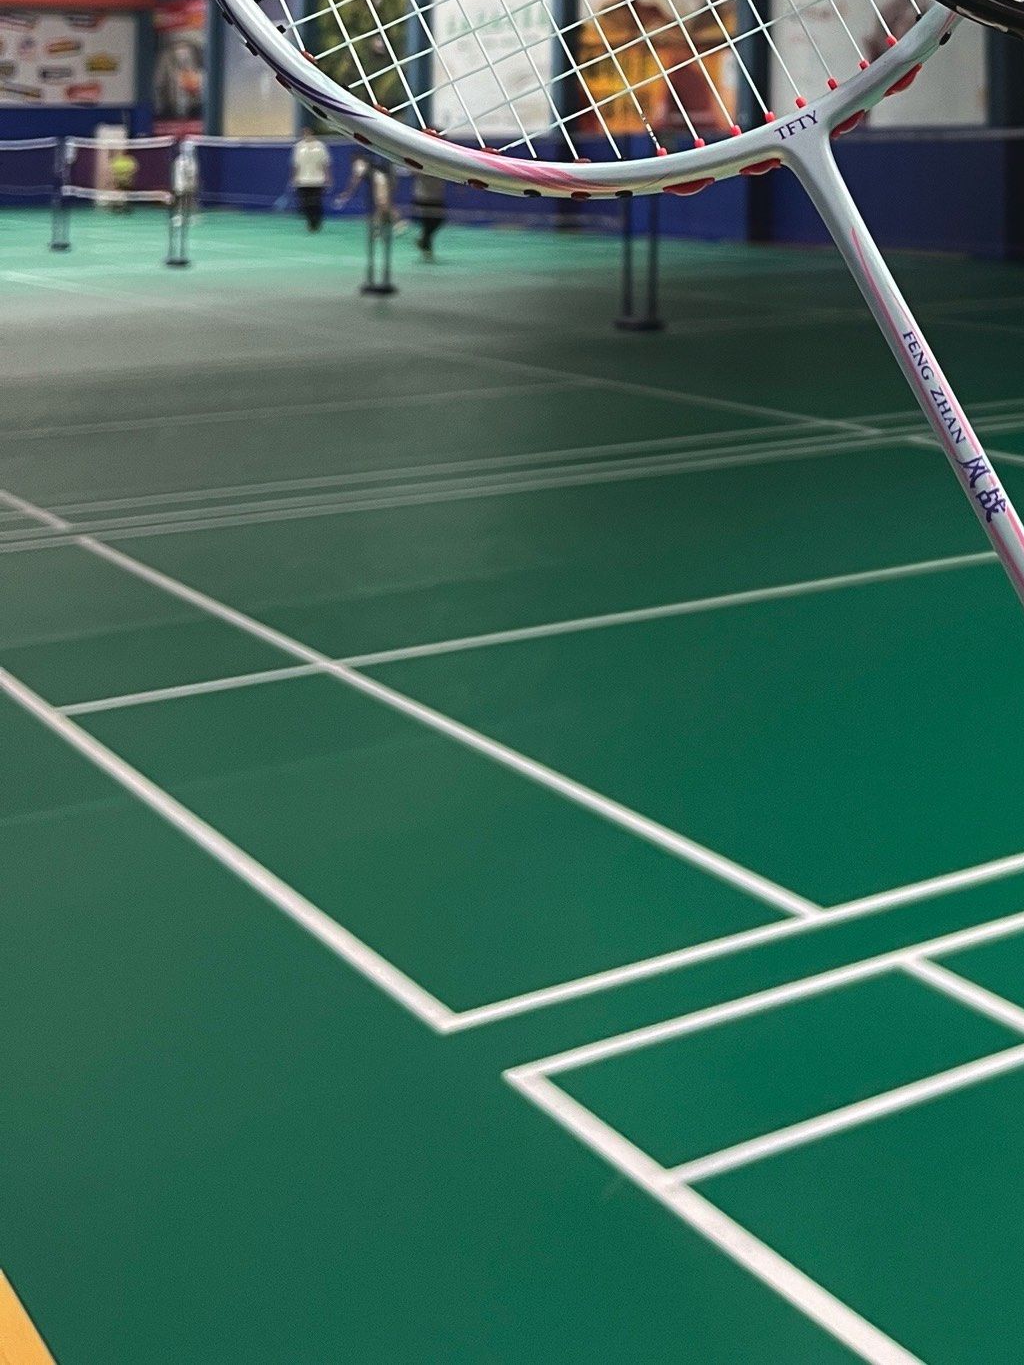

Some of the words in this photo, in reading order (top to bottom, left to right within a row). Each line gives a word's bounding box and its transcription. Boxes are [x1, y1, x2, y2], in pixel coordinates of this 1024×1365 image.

[774, 109, 818, 141] TFTY
[902, 331, 935, 381] FENG
[930, 386, 966, 445] ZHAN
